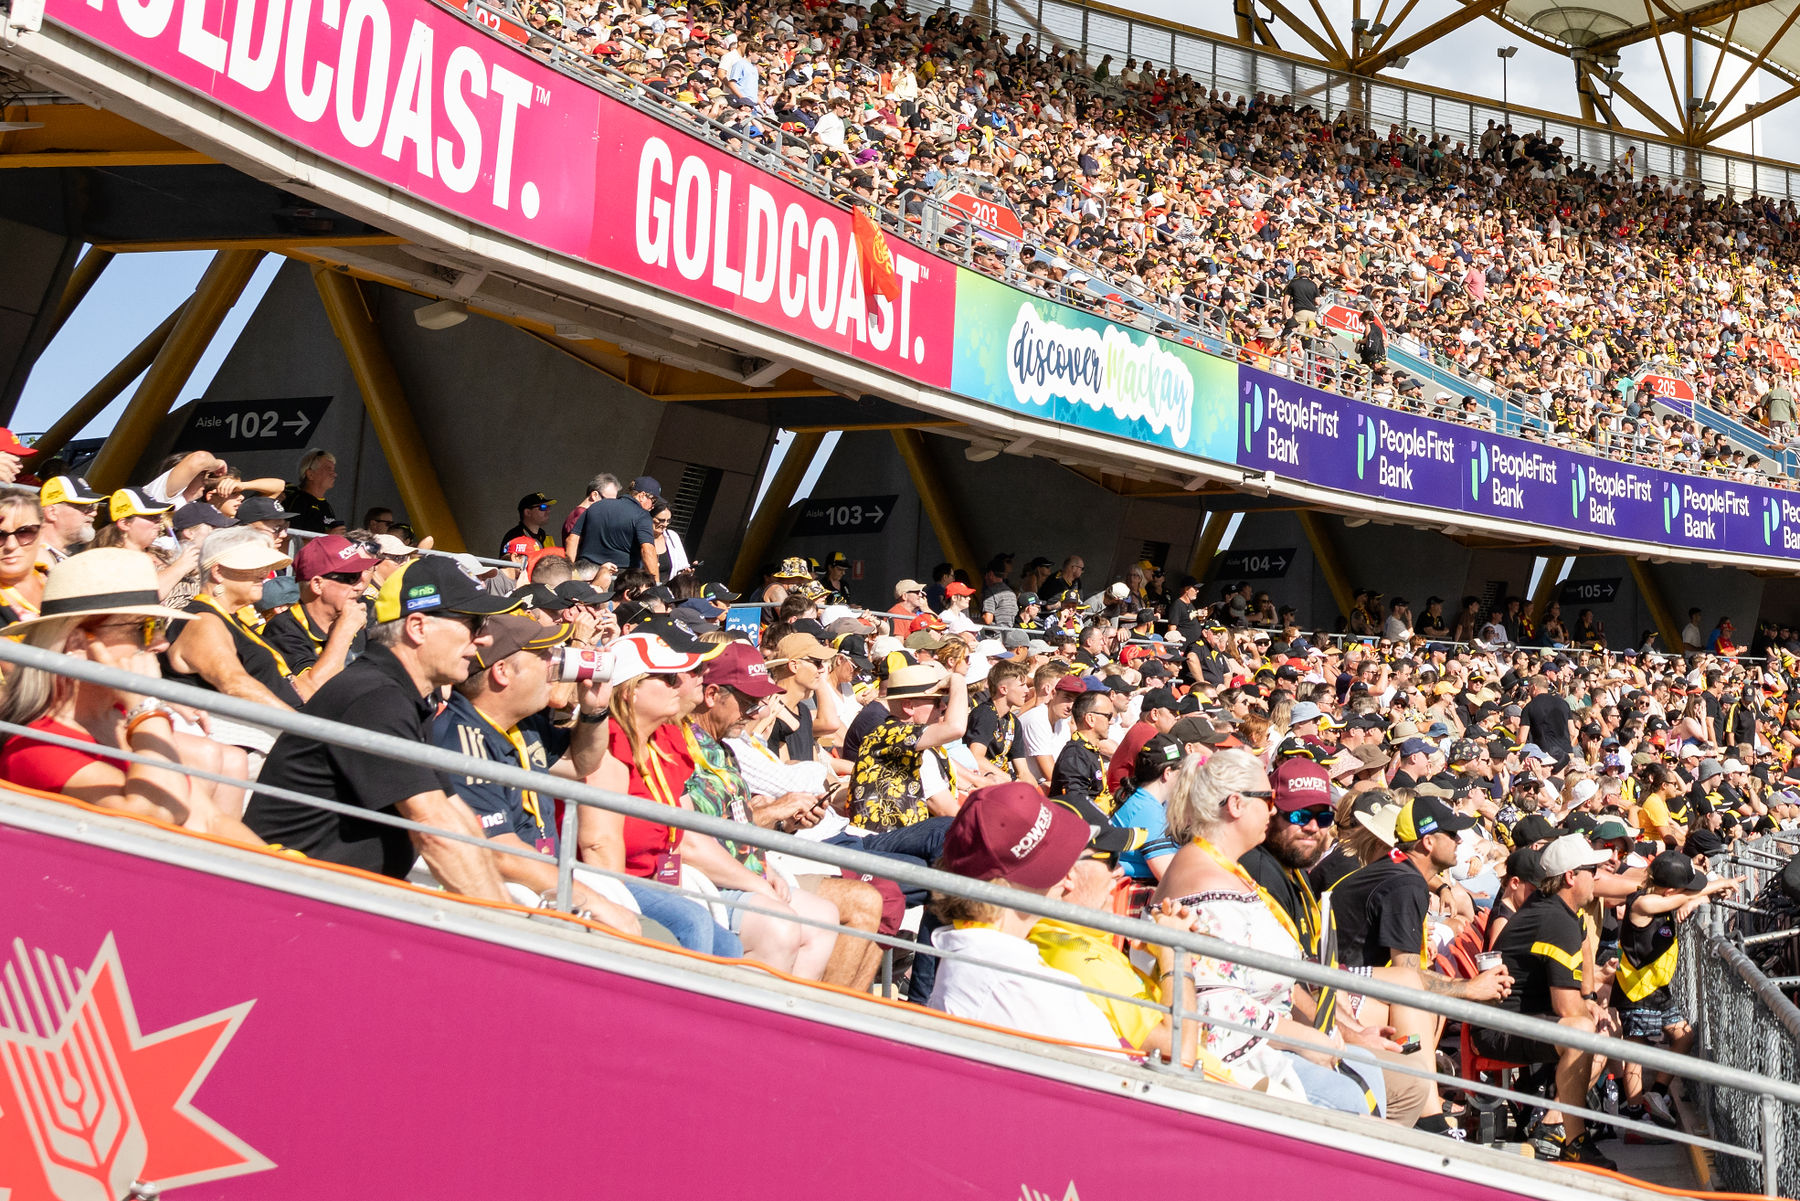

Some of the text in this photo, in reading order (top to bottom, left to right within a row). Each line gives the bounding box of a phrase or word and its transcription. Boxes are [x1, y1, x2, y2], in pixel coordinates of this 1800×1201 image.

[971, 201, 998, 230] 203
[1013, 320, 1103, 394] discover
[1657, 378, 1676, 397] 205
[195, 410, 279, 439] Aisle 102
[1267, 426, 1299, 466] Bank
[1379, 455, 1413, 490] Bank
[1492, 477, 1524, 509] Bank
[826, 505, 863, 526] 103
[1589, 496, 1616, 526] Bank
[1684, 512, 1715, 540] Bank
[1241, 556, 1270, 572] 104
[1577, 584, 1601, 598] 105
